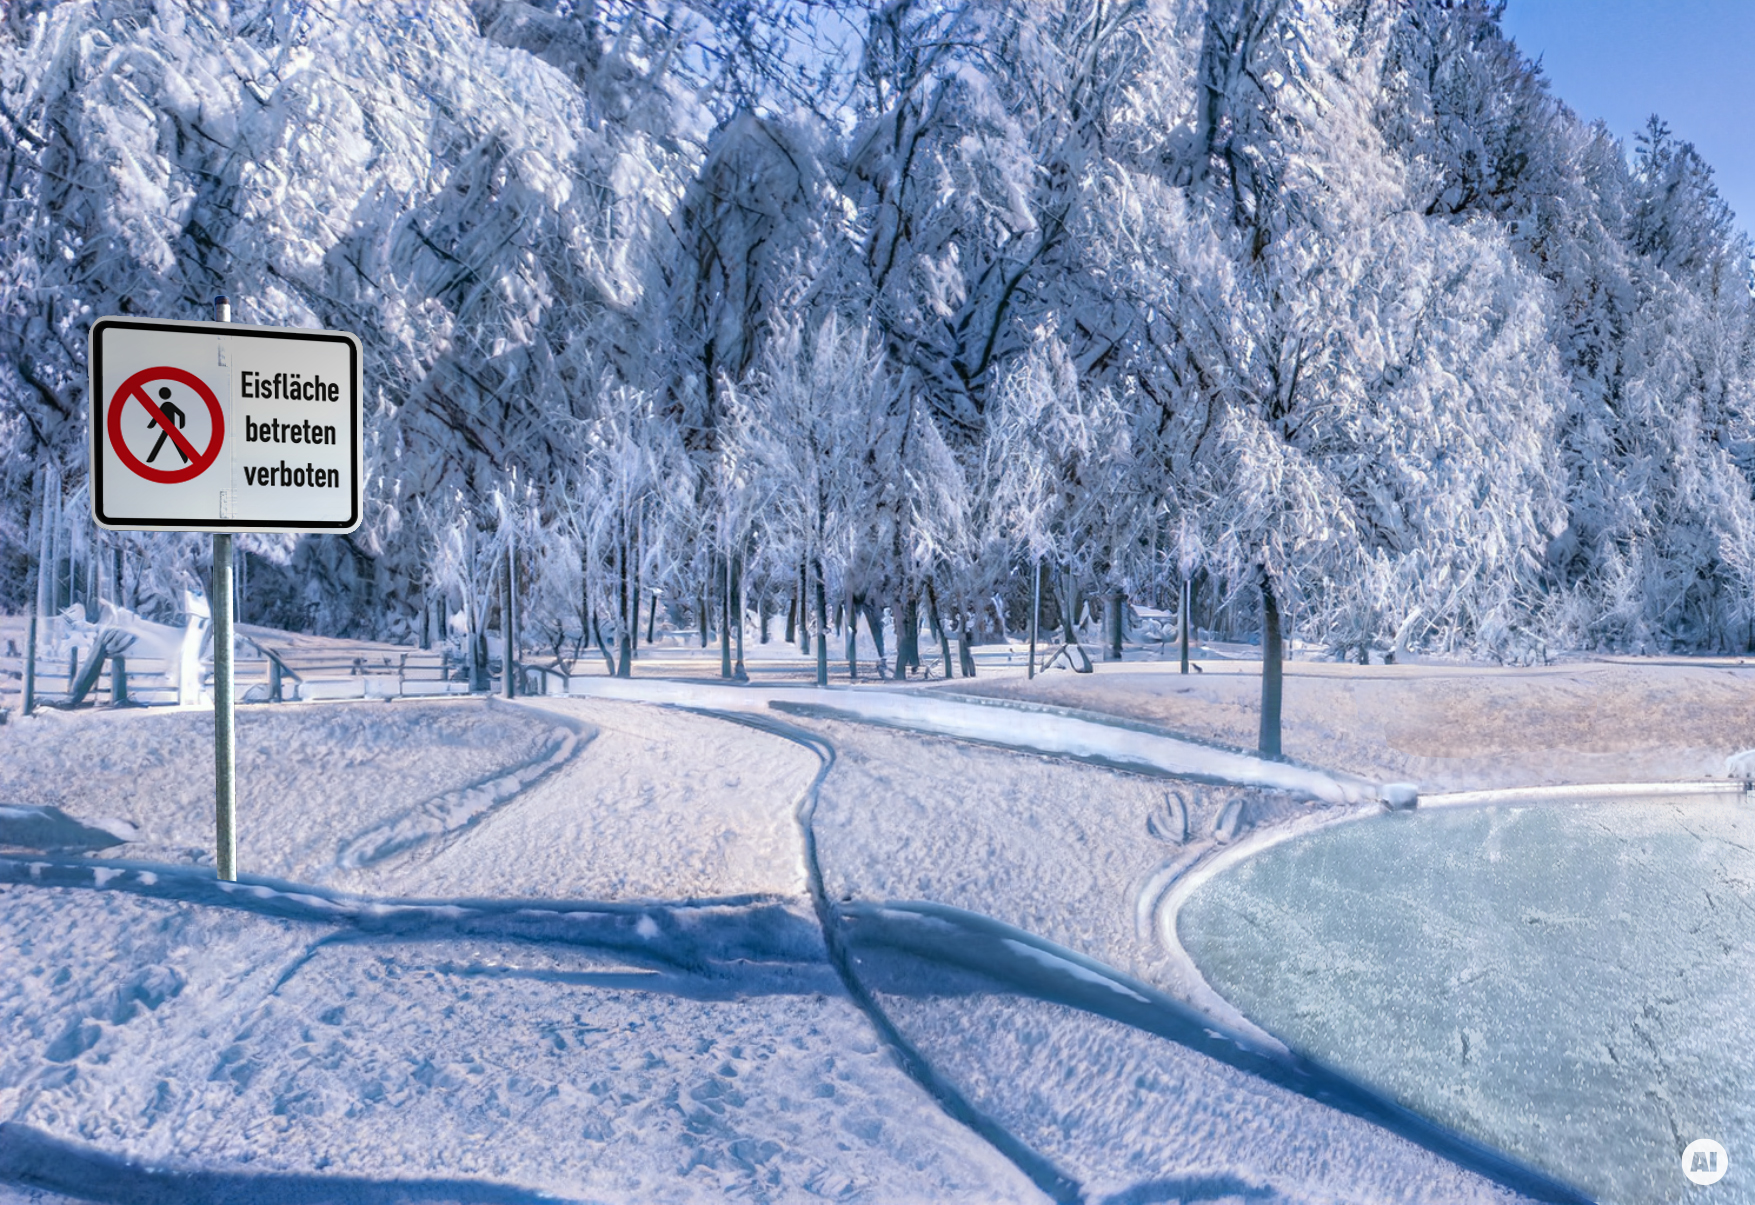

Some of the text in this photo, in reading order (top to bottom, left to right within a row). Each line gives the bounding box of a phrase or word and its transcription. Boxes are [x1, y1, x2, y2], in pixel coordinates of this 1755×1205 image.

[241, 370, 340, 402] Eisfläche
[245, 415, 336, 445] betreten
[243, 460, 340, 488] verboten
